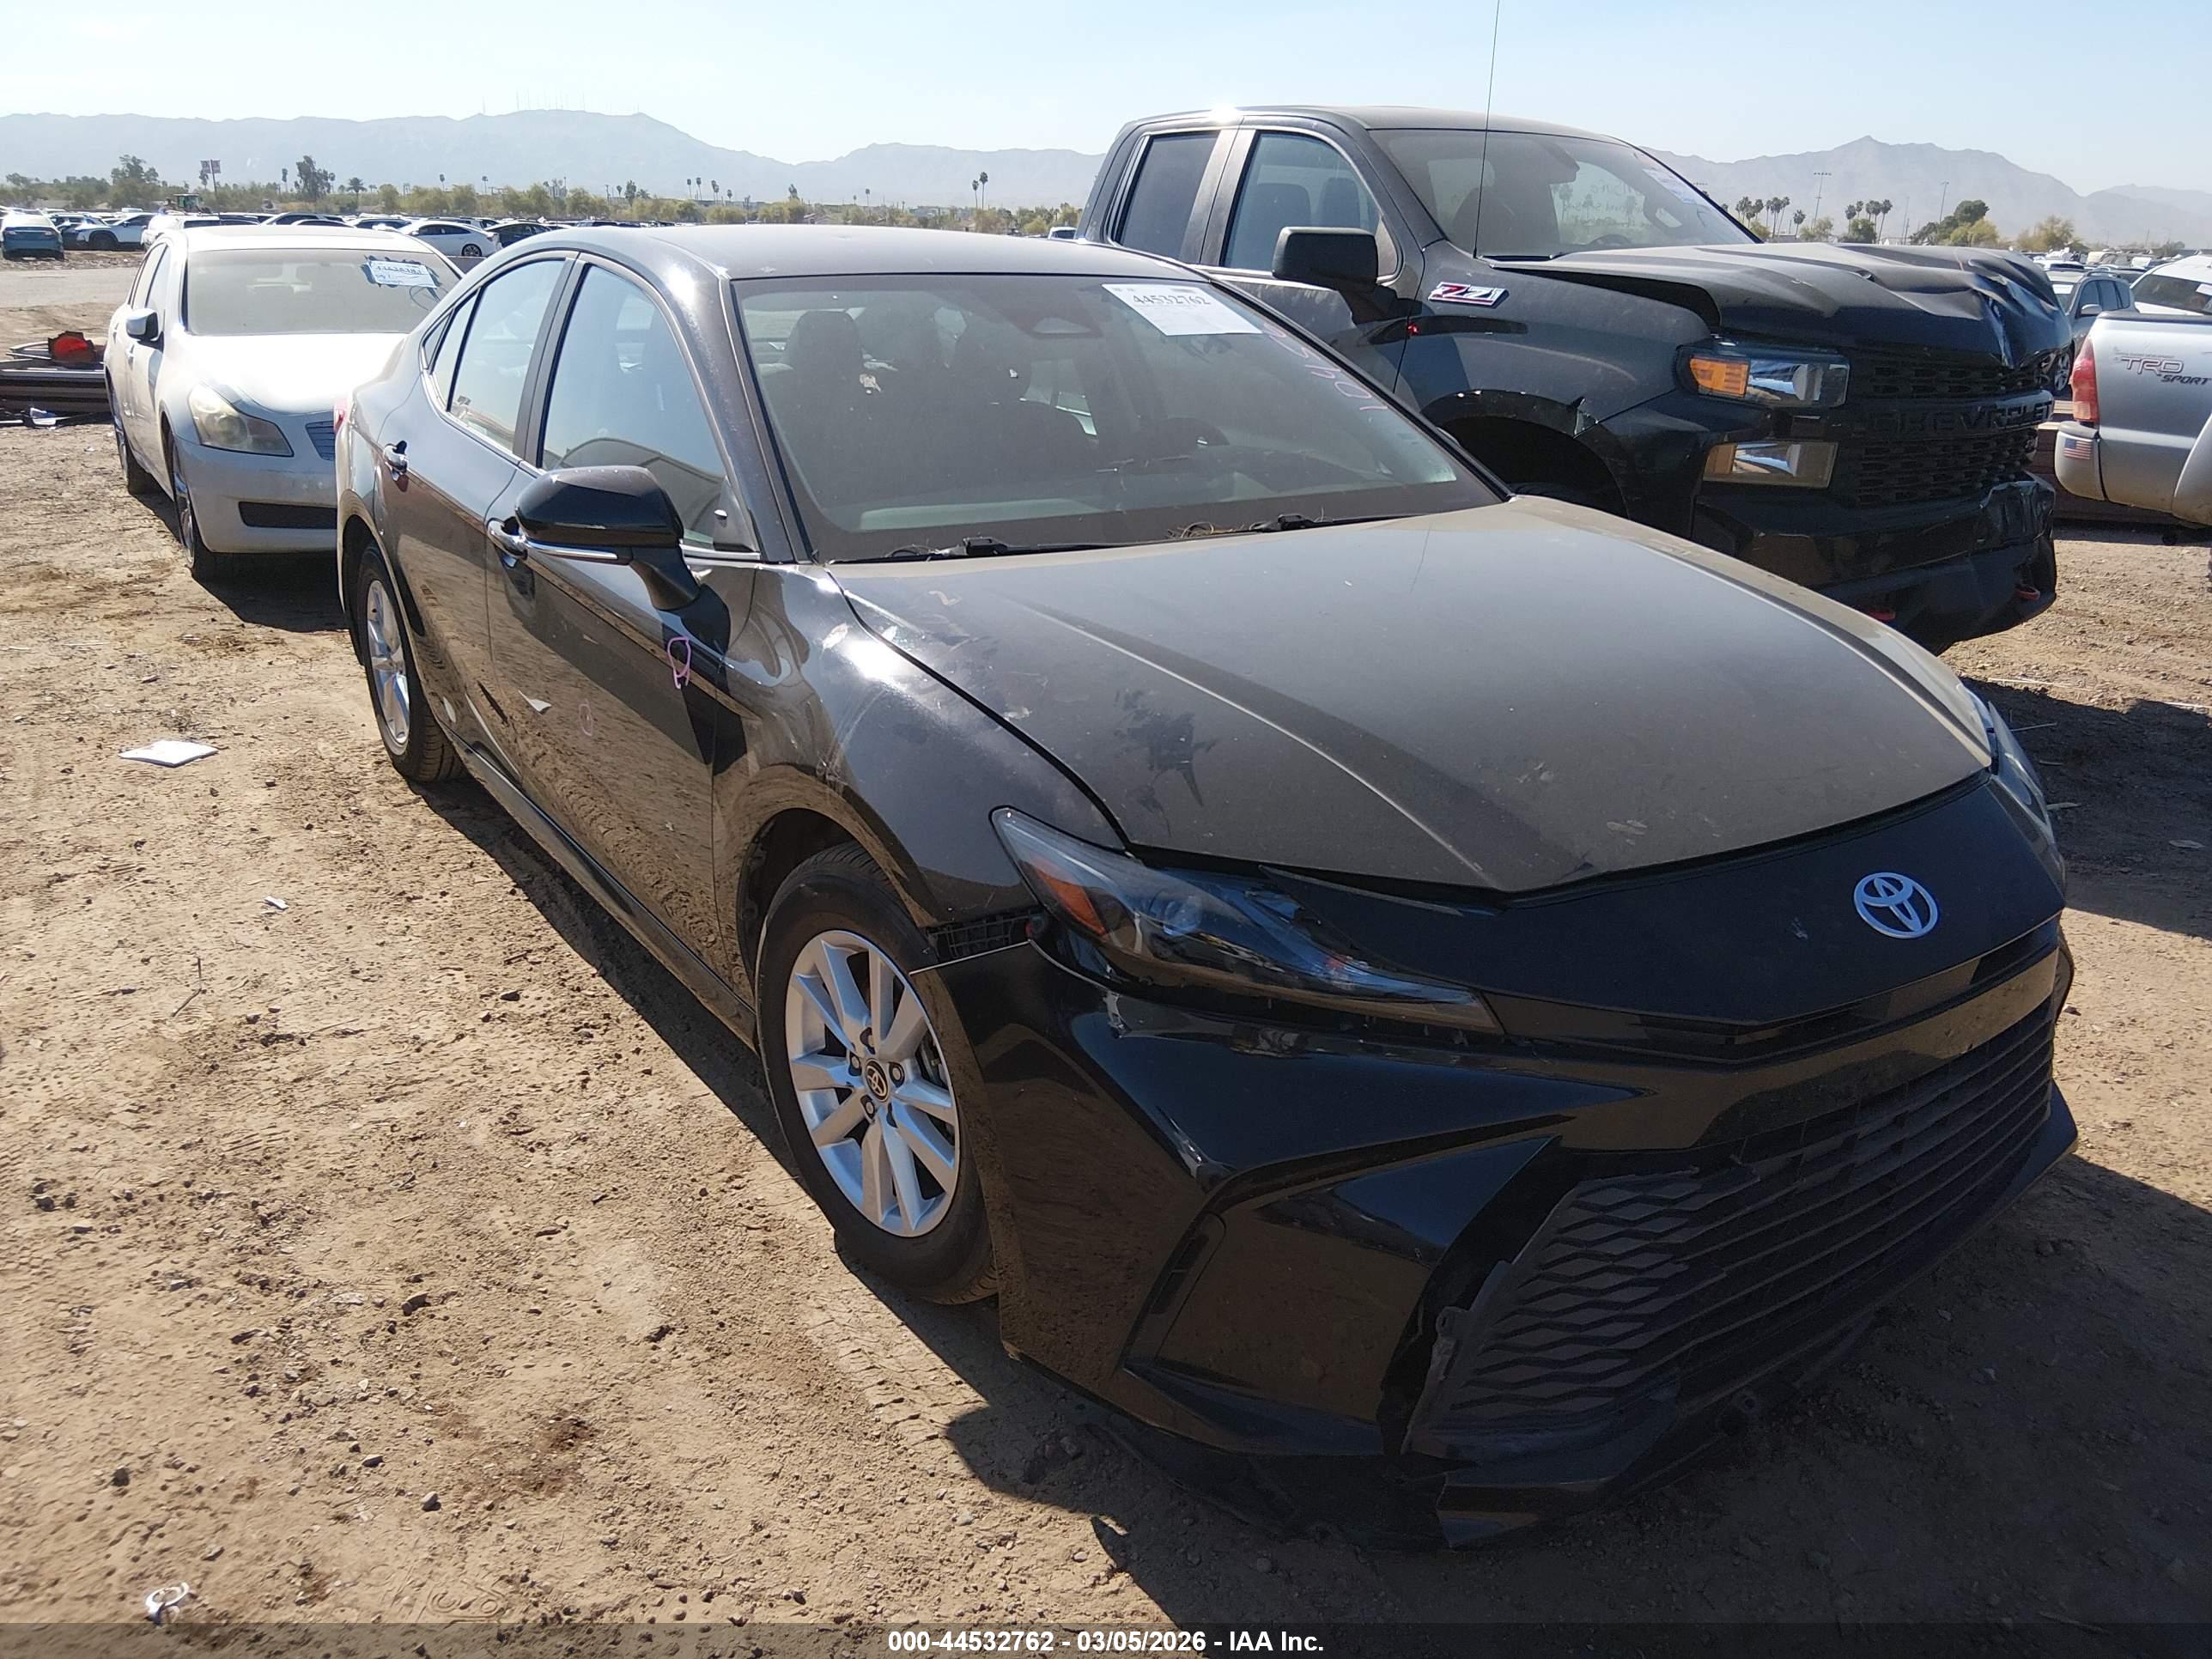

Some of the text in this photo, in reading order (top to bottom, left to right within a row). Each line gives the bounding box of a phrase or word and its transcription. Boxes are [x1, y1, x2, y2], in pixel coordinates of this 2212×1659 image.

[1133, 295, 1212, 305] 44532762
[2120, 357, 2185, 376] TRD
[2160, 374, 2209, 385] SPORT
